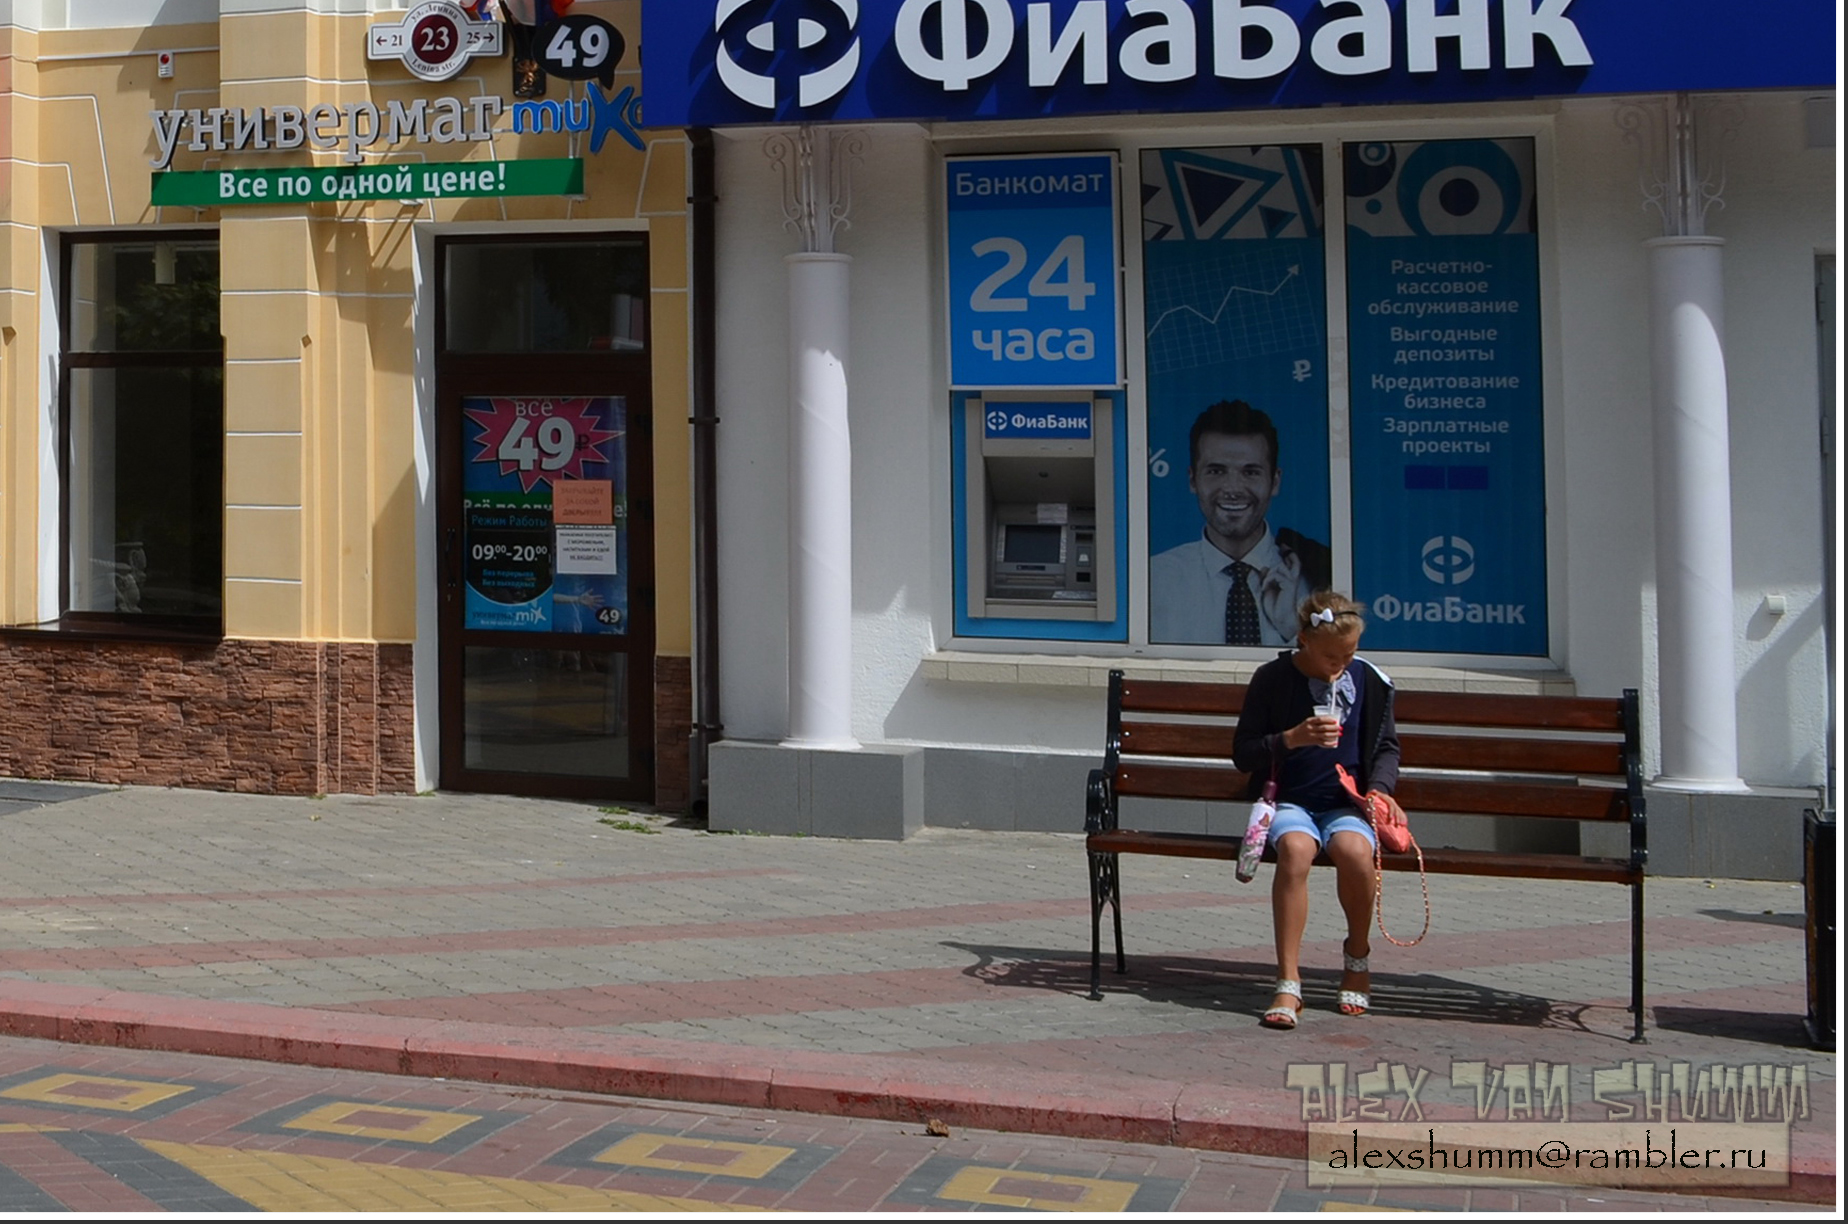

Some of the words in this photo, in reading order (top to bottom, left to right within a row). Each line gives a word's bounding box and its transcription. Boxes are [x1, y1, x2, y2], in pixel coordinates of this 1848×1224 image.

[392, 34, 403, 46] 21
[420, 26, 450, 52] 23
[466, 32, 480, 44] 25
[545, 24, 610, 68] 49
[149, 95, 503, 169] универмаг
[220, 172, 267, 199] Все
[277, 176, 311, 197] по
[322, 166, 412, 199] одной
[423, 164, 505, 195] цене!
[956, 173, 1103, 197] Банкомат
[969, 235, 1096, 312] 24
[1391, 260, 1492, 274] Расчетно-
[1397, 280, 1489, 294] кассовое
[1368, 300, 1519, 318] обслуживание
[1390, 327, 1497, 343] Выгодные
[972, 328, 1095, 361] часа
[1394, 348, 1494, 364] депозиты
[1371, 374, 1520, 392] Кредитование
[1404, 394, 1486, 409] бизнеса
[1011, 413, 1088, 429] ФиаБанк
[1383, 417, 1510, 436] Зарплатные
[498, 417, 575, 470] 49
[1402, 441, 1490, 456] проекты
[472, 515, 506, 525] Режим
[510, 515, 547, 527] Работы
[483, 579, 495, 587] Без
[599, 609, 619, 623] 49
[1373, 594, 1525, 625] ФиаБанк
